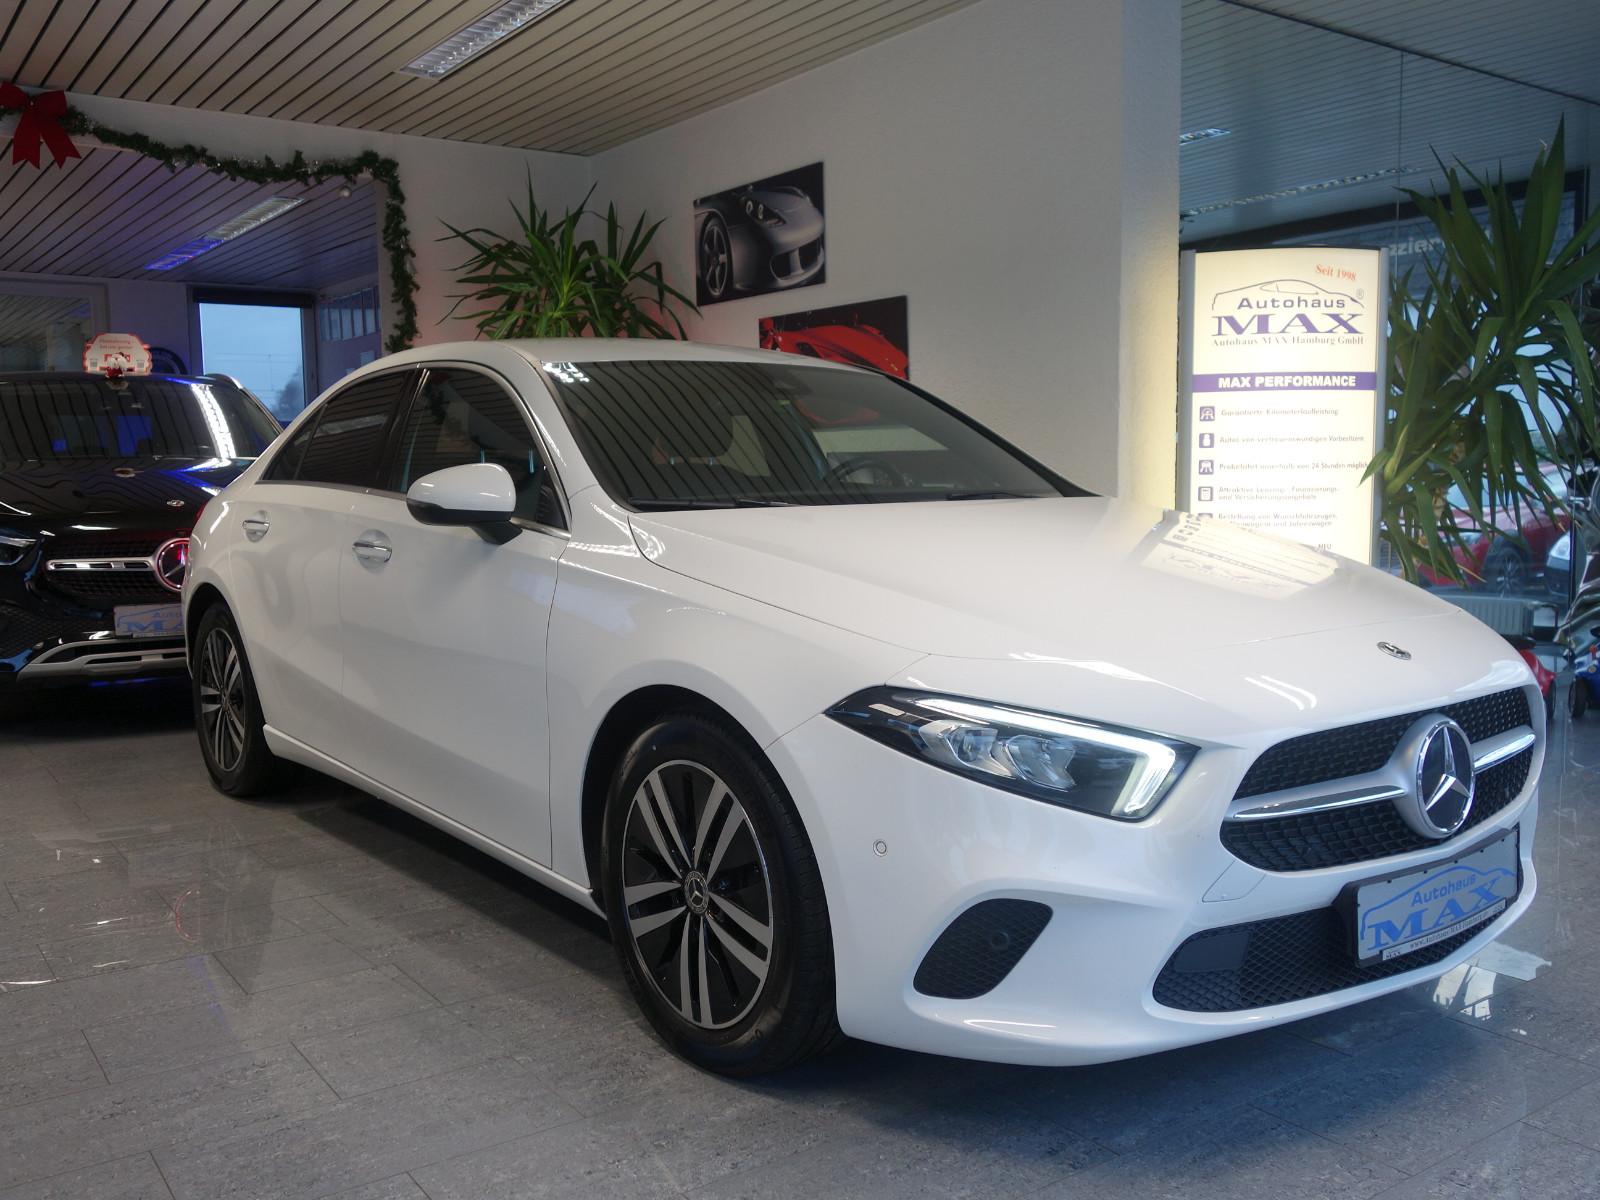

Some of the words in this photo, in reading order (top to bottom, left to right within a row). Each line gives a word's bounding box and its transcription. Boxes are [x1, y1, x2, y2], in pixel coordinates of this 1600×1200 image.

[1315, 264, 1334, 278] Seit
[1336, 270, 1357, 282] 1998
[1237, 296, 1346, 310] Autohaus
[1211, 313, 1364, 337] MAX
[1212, 337, 1259, 347] Autohaus
[1261, 336, 1288, 346] MAX
[1292, 335, 1336, 346] Hamburg
[1337, 335, 1364, 346] GmbH
[1218, 377, 1251, 389] MAX
[1255, 375, 1356, 388] PERFORMANCE
[1311, 462, 1320, 471] 24
[1321, 461, 1346, 470] Stunden
[1411, 873, 1477, 907] Autohaus
[1367, 876, 1501, 951] MAX
